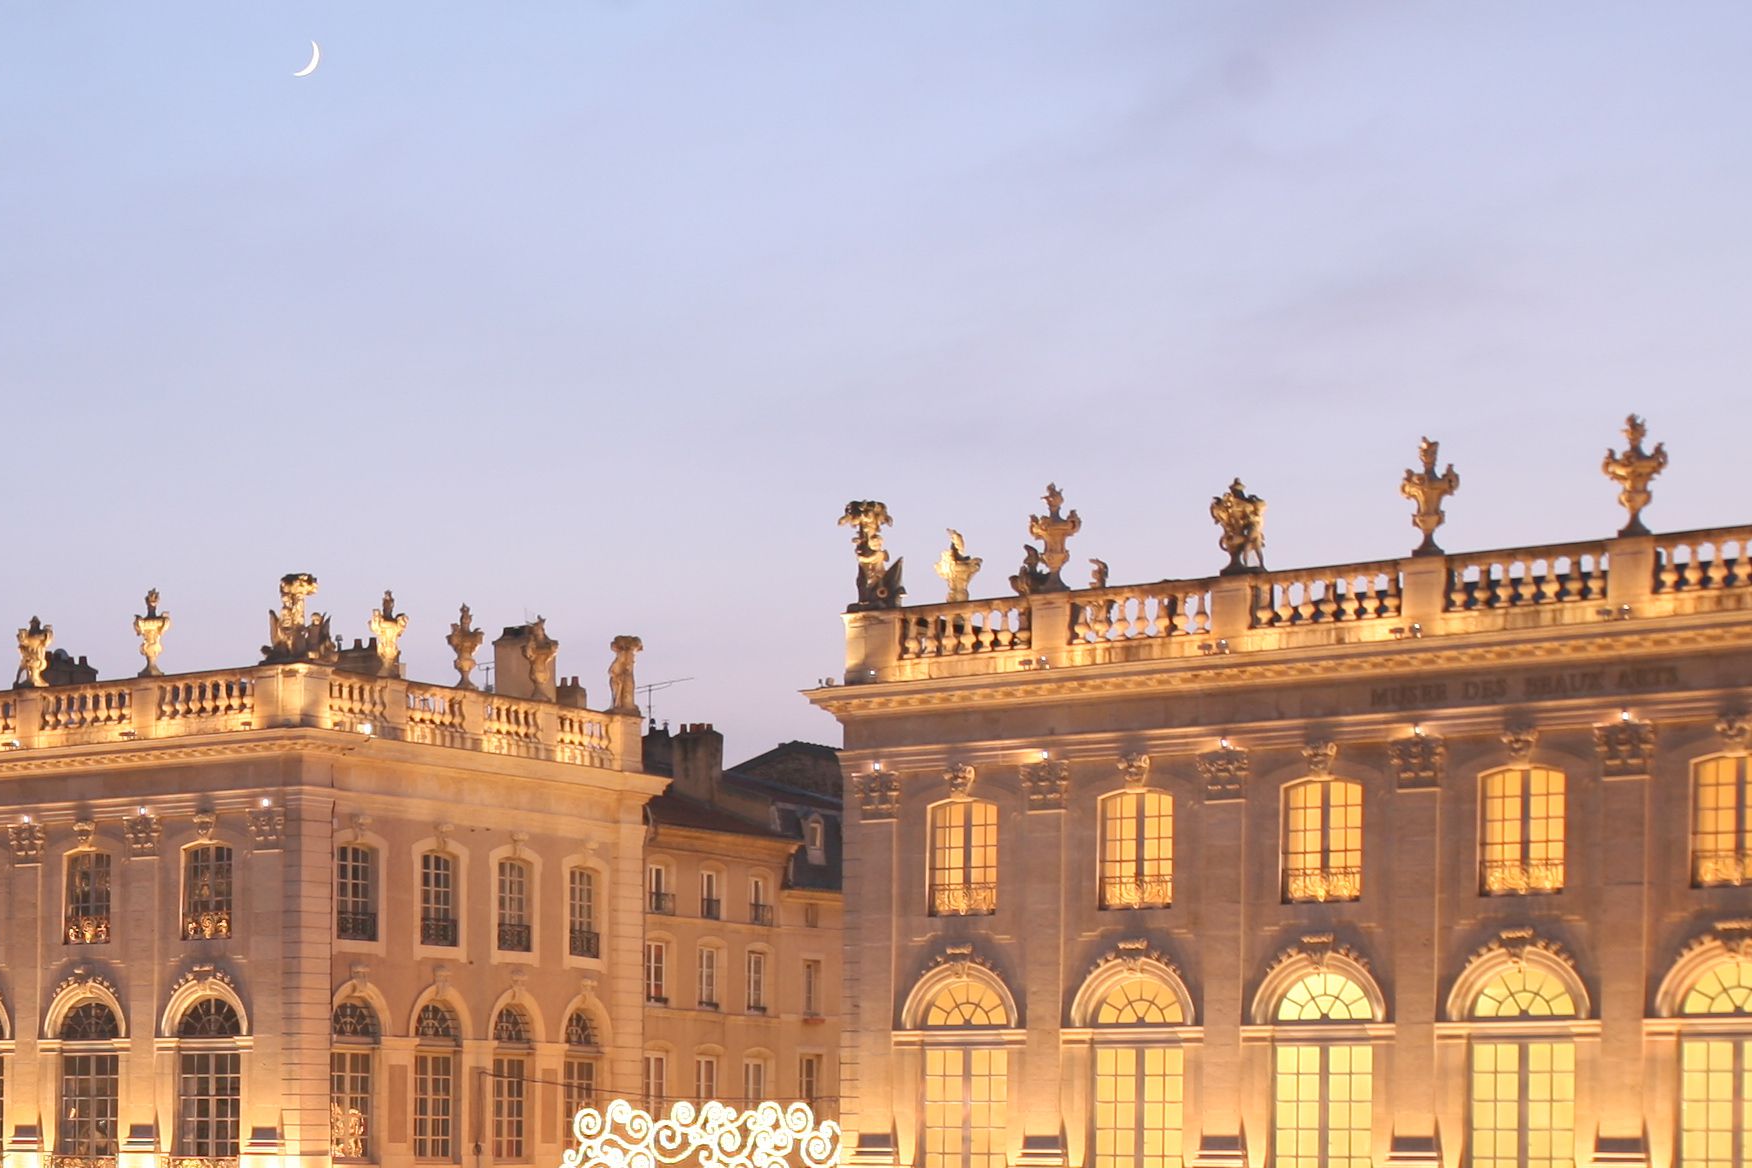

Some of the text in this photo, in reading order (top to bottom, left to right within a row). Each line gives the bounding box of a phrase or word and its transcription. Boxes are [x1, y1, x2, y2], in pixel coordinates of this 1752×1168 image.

[1463, 677, 1507, 700] DES
[1524, 672, 1607, 697] BEAUX
[1615, 666, 1679, 690] ARTS
